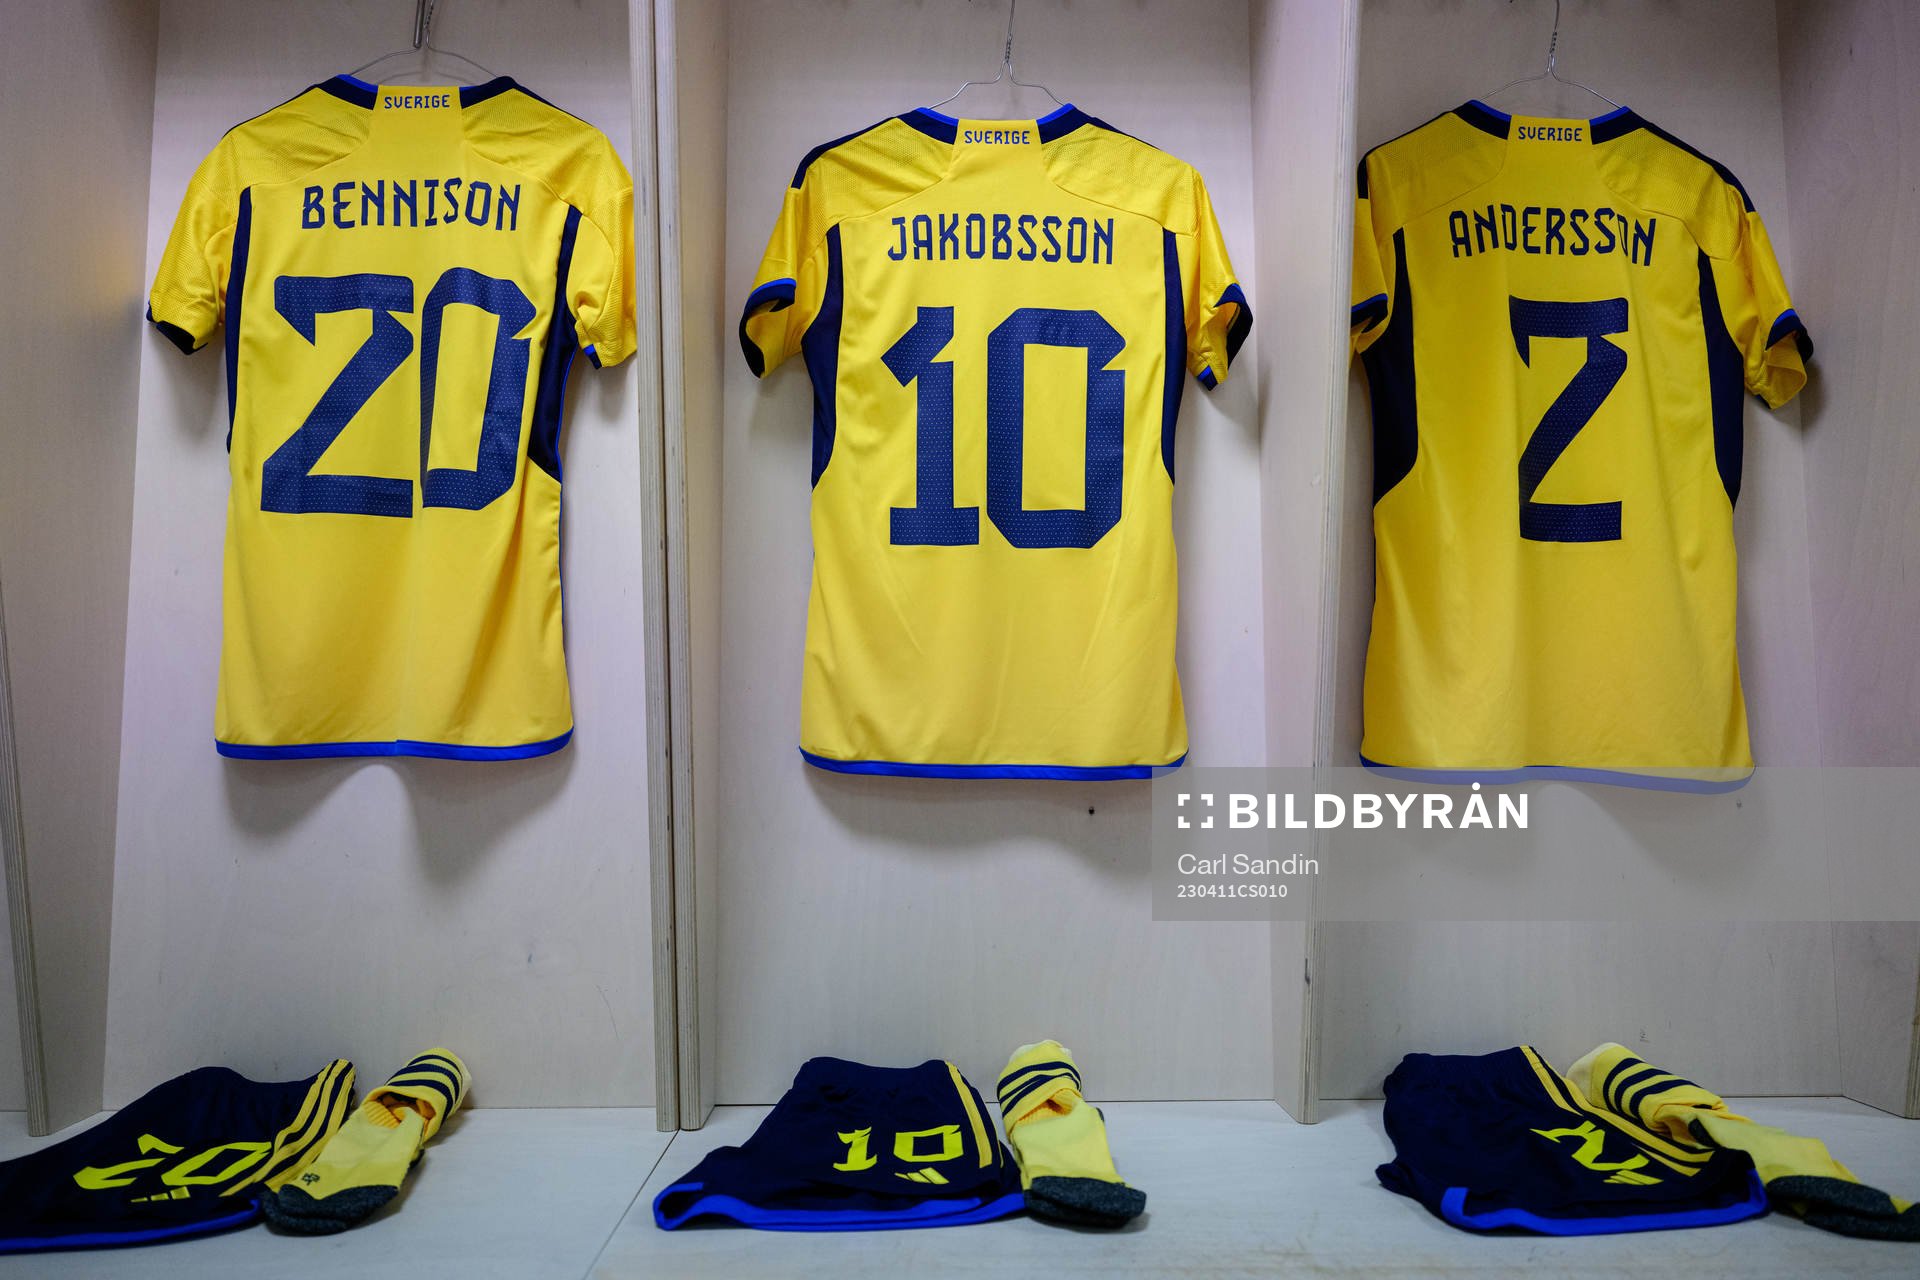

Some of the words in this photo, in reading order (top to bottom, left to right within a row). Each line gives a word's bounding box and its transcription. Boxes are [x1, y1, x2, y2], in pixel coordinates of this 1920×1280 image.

[384, 94, 450, 110] SVERIGE
[964, 130, 1031, 145] SVERIGE
[1517, 126, 1583, 142] SVERIGE
[302, 177, 521, 231] BENNISON
[887, 213, 1115, 265] JAKOBSSON
[1449, 204, 1657, 267] ANDERSSON
[260, 267, 537, 518] 20
[1508, 295, 1630, 543] 2
[880, 306, 1127, 549] 10
[833, 1124, 964, 1172] 10
